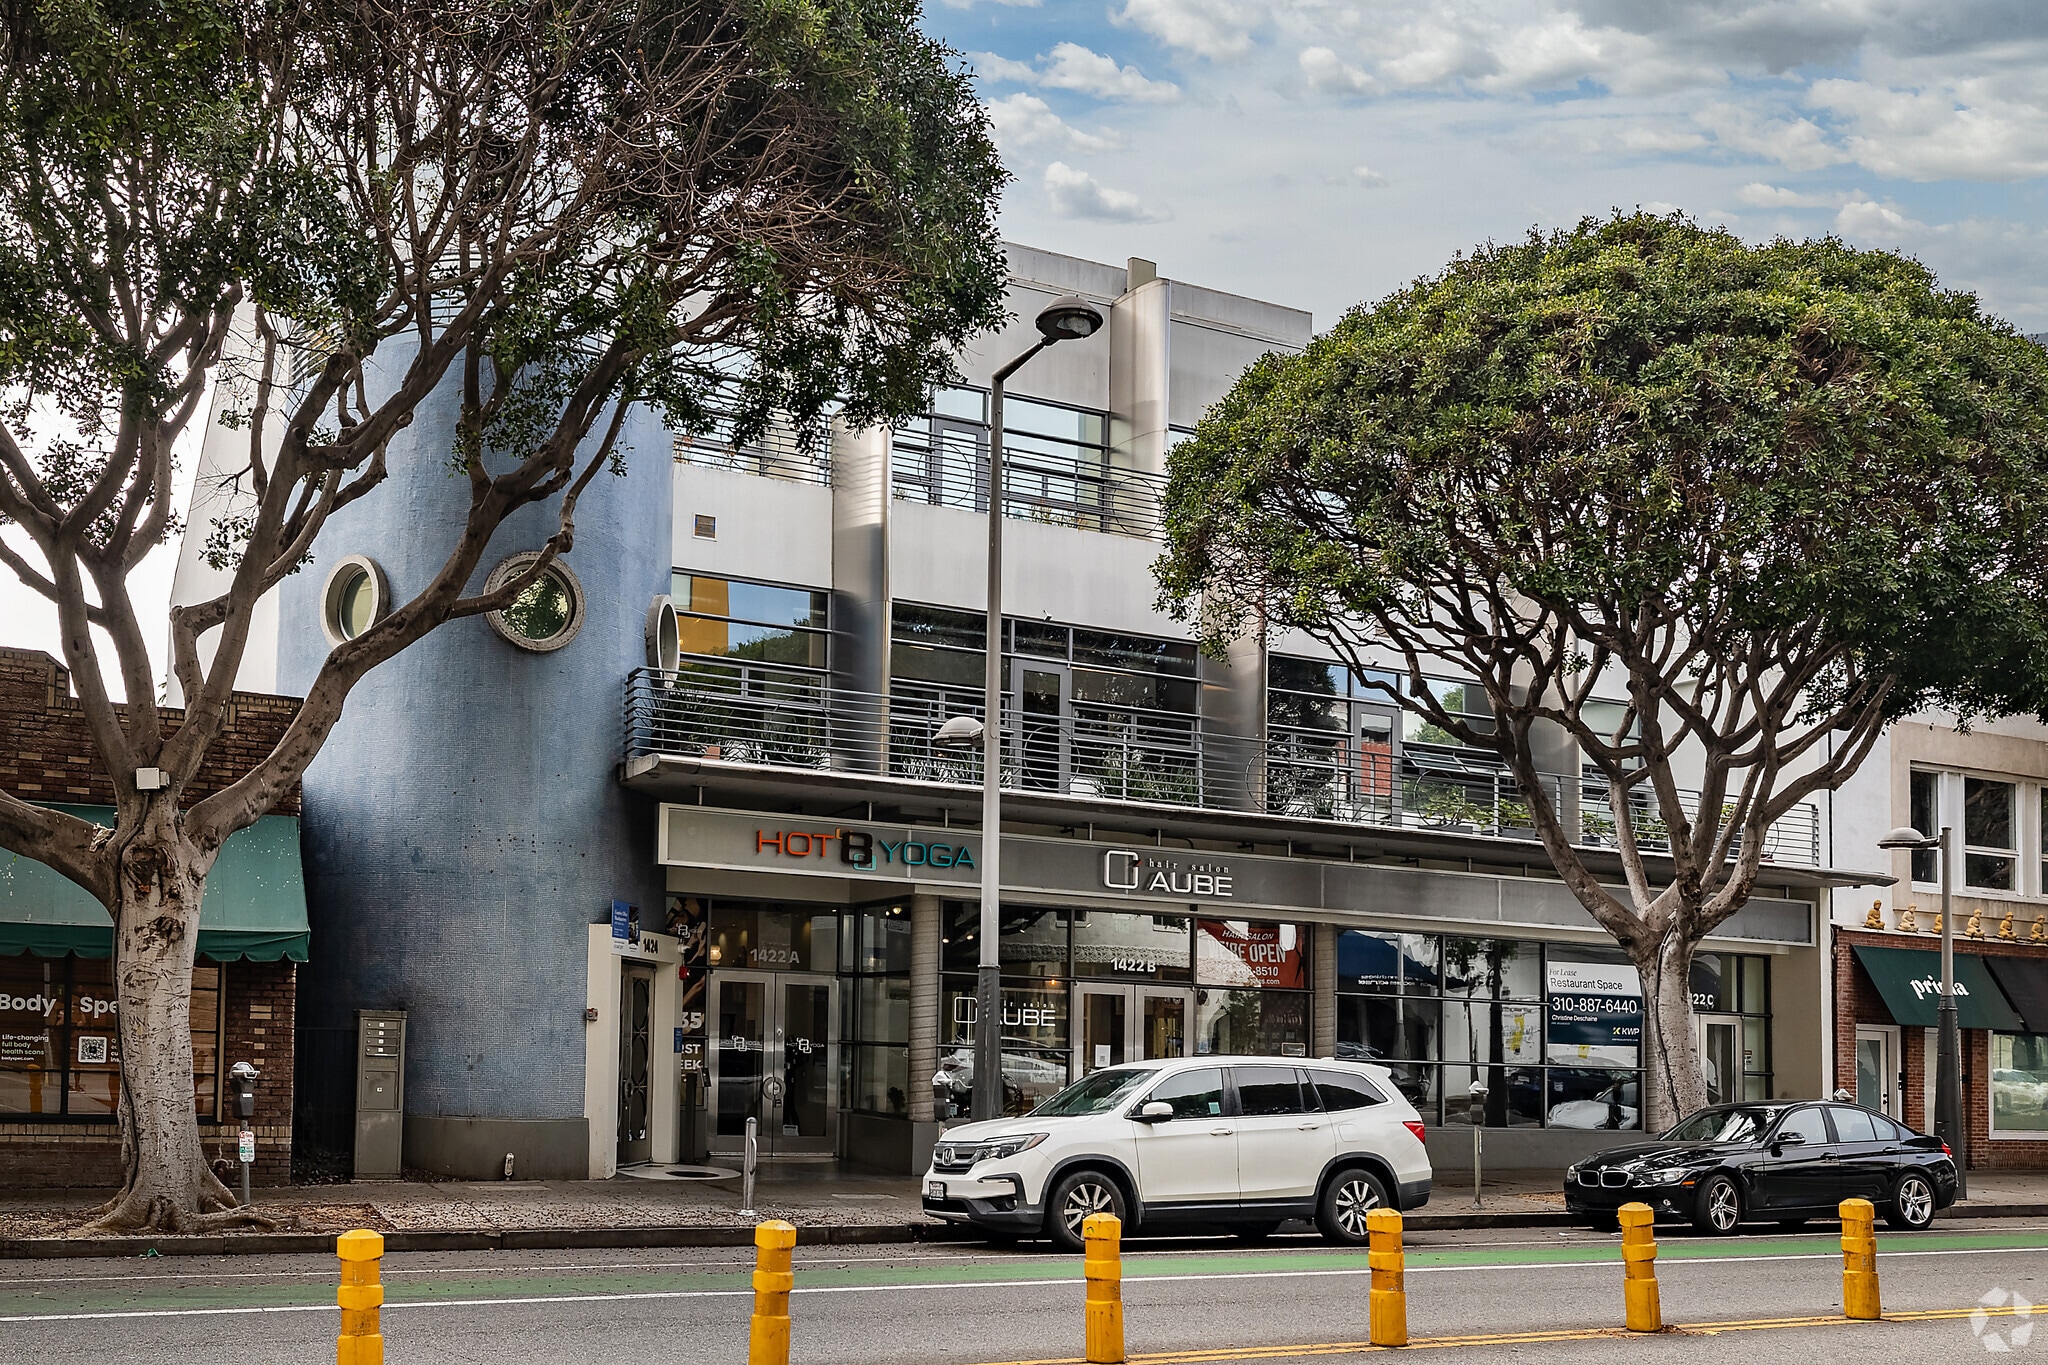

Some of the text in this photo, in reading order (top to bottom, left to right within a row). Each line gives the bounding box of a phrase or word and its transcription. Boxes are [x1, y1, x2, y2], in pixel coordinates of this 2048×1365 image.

[756, 829, 835, 858] HOT
[878, 839, 976, 870] YOGA
[1148, 858, 1229, 874] hair salon
[1148, 871, 1233, 897] AUBE
[1246, 932, 1275, 941] SALON
[643, 937, 659, 954] 1424
[1249, 943, 1286, 963] OPEN
[750, 948, 800, 964] 1422 A
[1110, 956, 1157, 973] 1422 B
[1549, 968, 1578, 977] For Lease
[1550, 978, 1623, 991] Restaurant Space
[0, 993, 119, 1019] Body Spe
[1552, 996, 1638, 1014] 310-887-6440
[1000, 1008, 1056, 1028] UBE
[1551, 1014, 1598, 1023] Christine Deschaine
[2, 1034, 49, 1043] Life-changing
[1621, 1027, 1640, 1037] KWP
[13, 1042, 32, 1050] body
